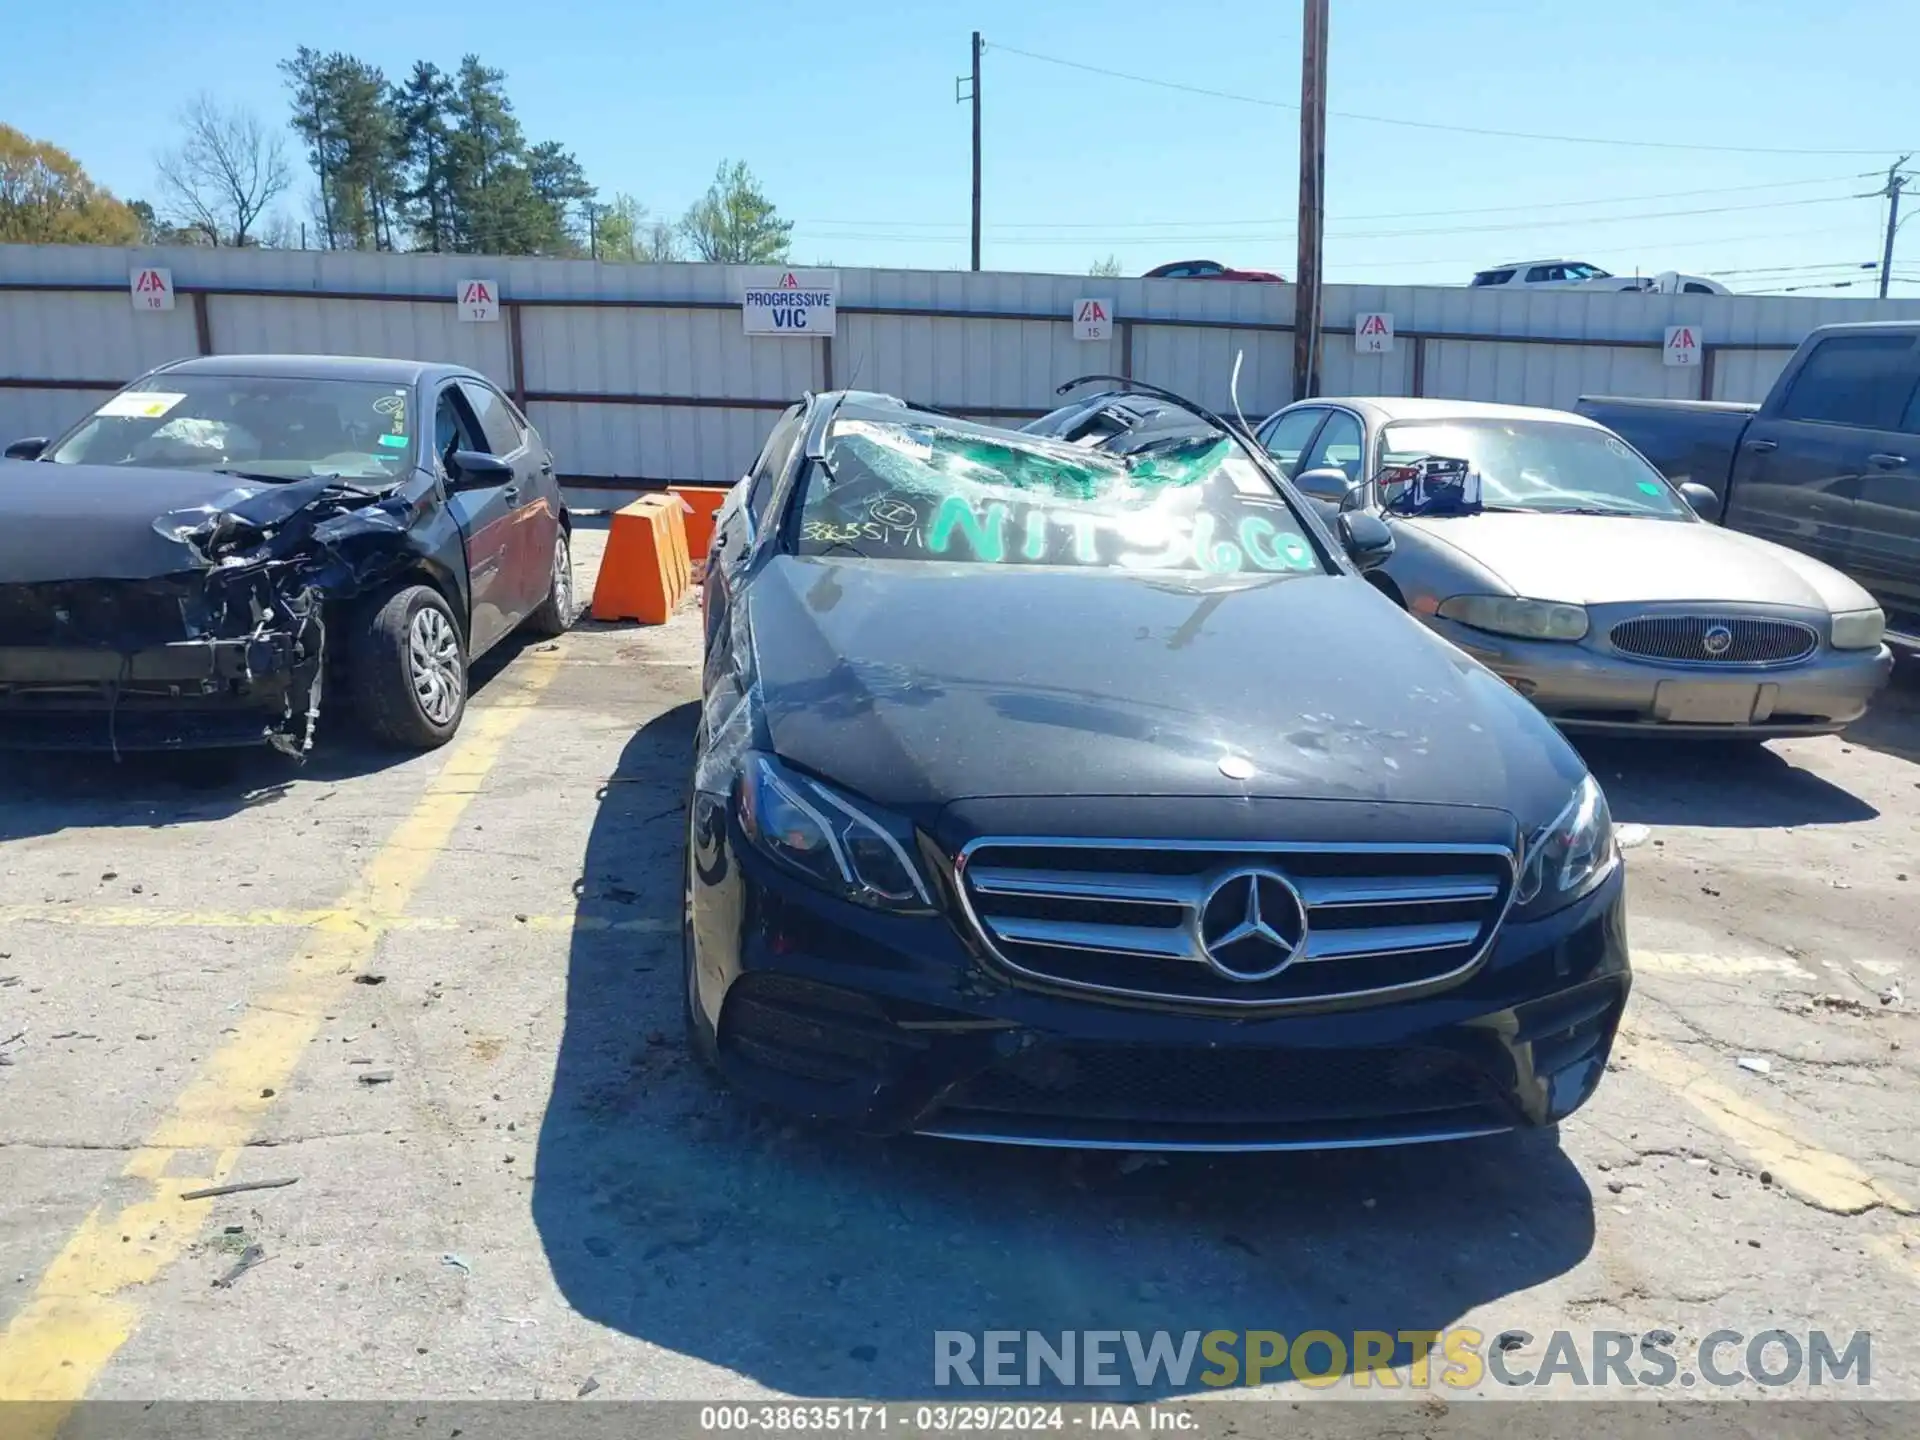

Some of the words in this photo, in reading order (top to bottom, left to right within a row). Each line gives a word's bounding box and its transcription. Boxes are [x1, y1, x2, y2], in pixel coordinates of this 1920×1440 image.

[745, 291, 831, 307] PROGRESSIVE
[472, 308, 487, 319] 17
[772, 308, 808, 328] VIC
[1087, 327, 1100, 338] 15
